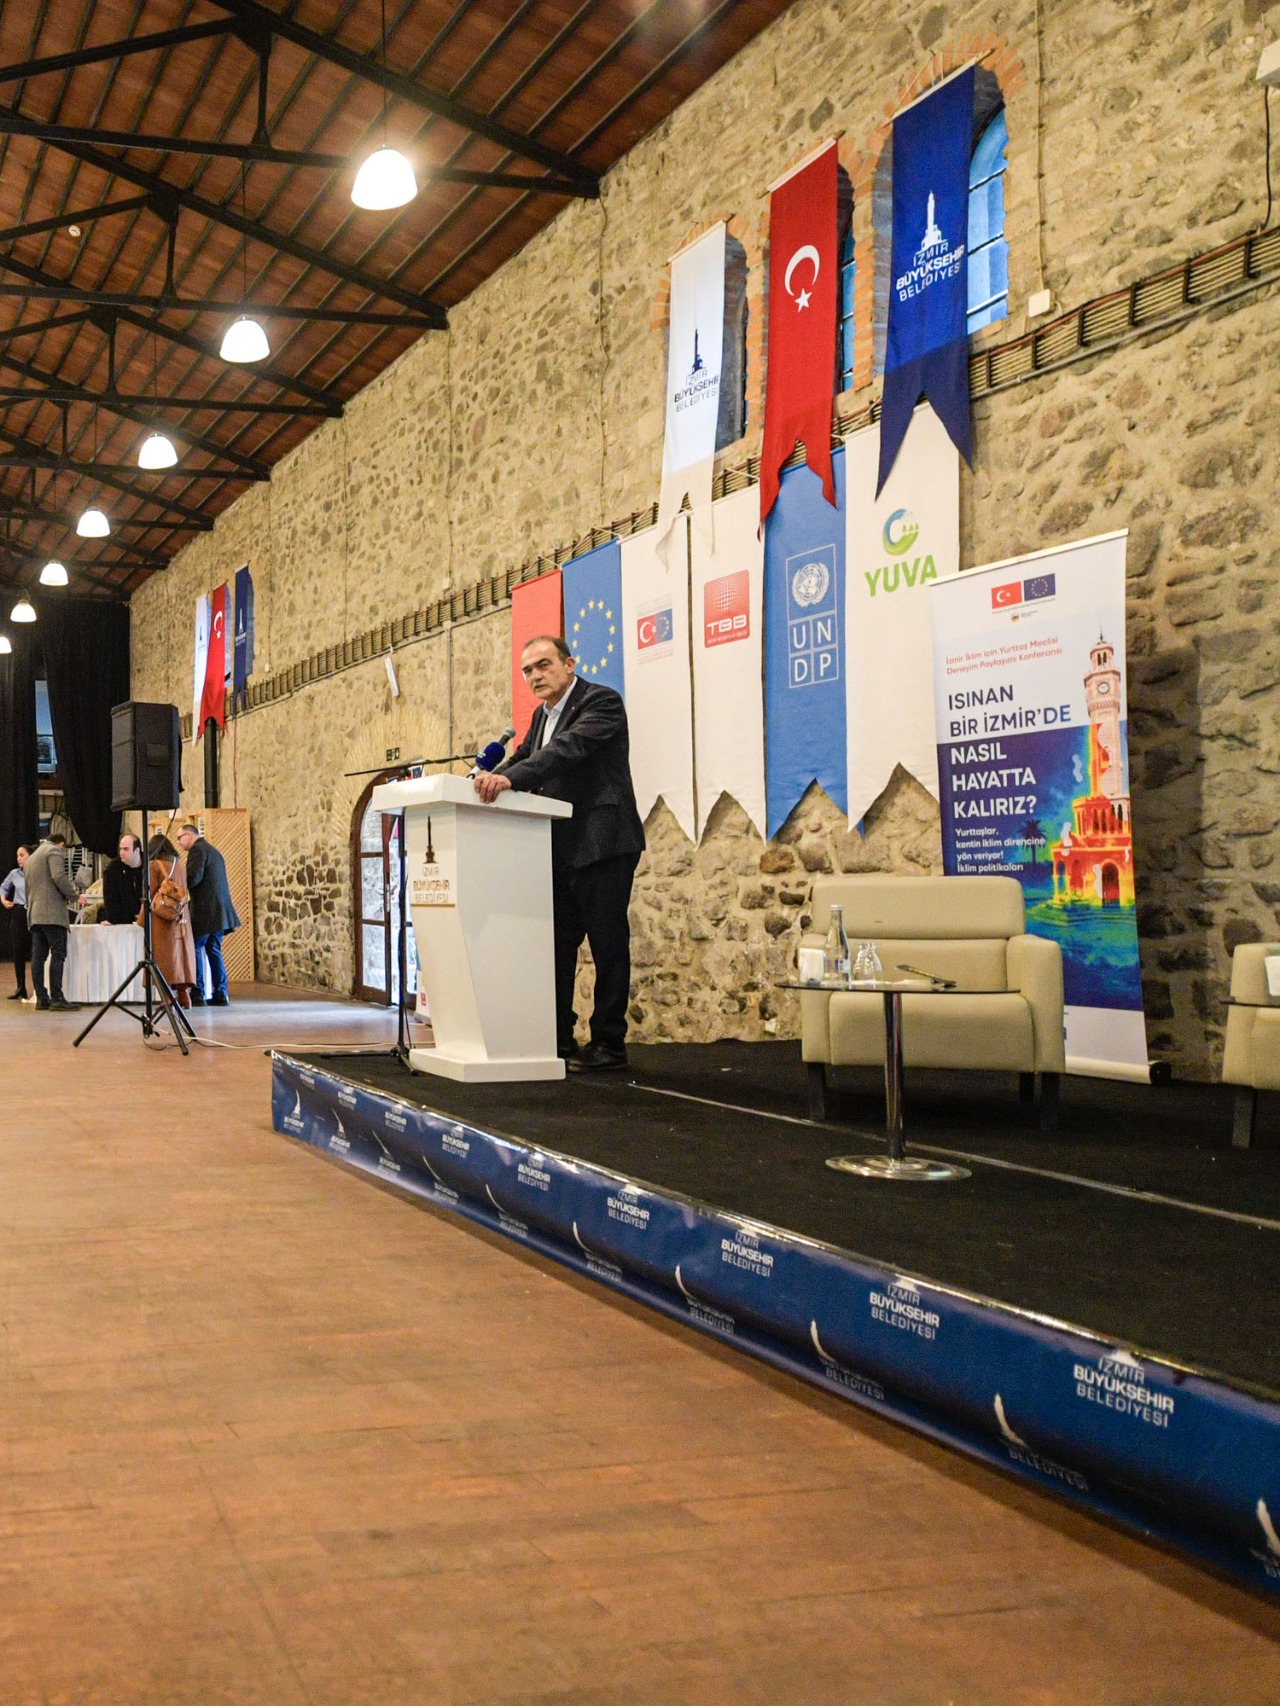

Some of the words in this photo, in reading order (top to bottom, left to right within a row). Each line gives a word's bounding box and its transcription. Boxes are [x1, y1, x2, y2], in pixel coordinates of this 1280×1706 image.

[864, 554, 938, 597] YUVA
[707, 614, 747, 635] TBB
[948, 685, 1014, 710] ISINAN
[950, 715, 978, 737] BİR
[984, 705, 1072, 732] İZMİR'DE
[951, 742, 1007, 765] NASIL
[952, 767, 1036, 792] HAYATTA
[953, 795, 1037, 819] KALIRIZ?
[956, 839, 981, 849] kentin
[982, 839, 1002, 847] iklim
[1004, 837, 1045, 846] direncine
[957, 852, 972, 862] yön
[974, 851, 1004, 861] veriyor!
[957, 862, 977, 873] İklim
[978, 863, 1024, 874] politikaları
